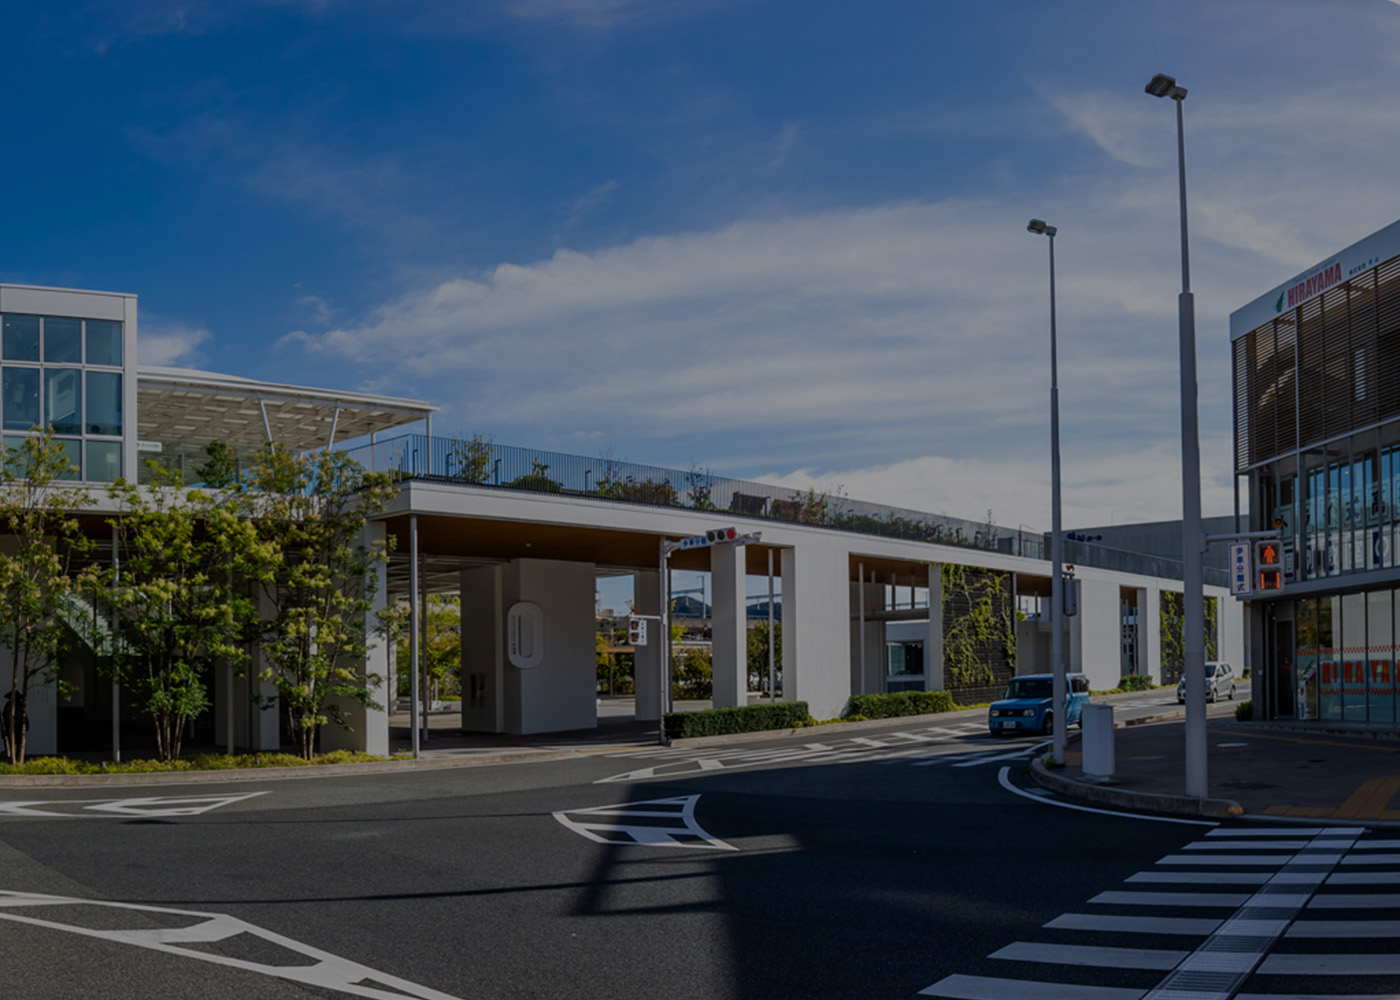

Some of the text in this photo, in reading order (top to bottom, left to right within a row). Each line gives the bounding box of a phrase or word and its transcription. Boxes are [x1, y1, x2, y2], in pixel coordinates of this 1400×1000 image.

[1288, 262, 1342, 308] HIRAYAMA
[683, 537, 706, 547] 歩車分離
[1236, 547, 1245, 591] 歩車分離式
